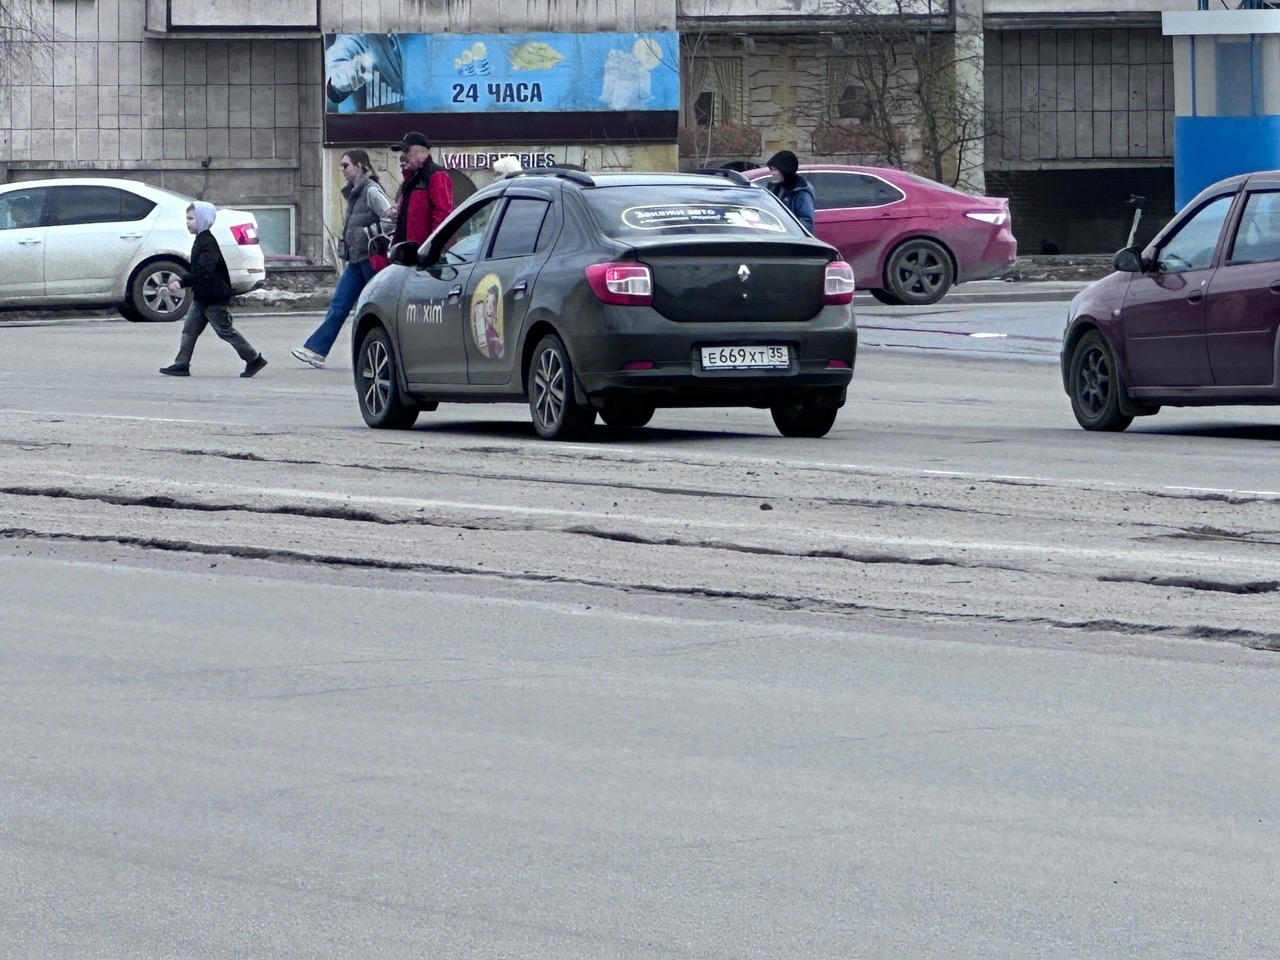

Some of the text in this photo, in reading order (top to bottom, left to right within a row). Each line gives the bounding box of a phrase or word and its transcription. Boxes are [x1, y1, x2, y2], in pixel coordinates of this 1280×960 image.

[452, 82, 543, 104] 24 ЧАСА
[442, 152, 556, 170] WILDBRIES
[708, 347, 784, 364] Е669ХТ 35
